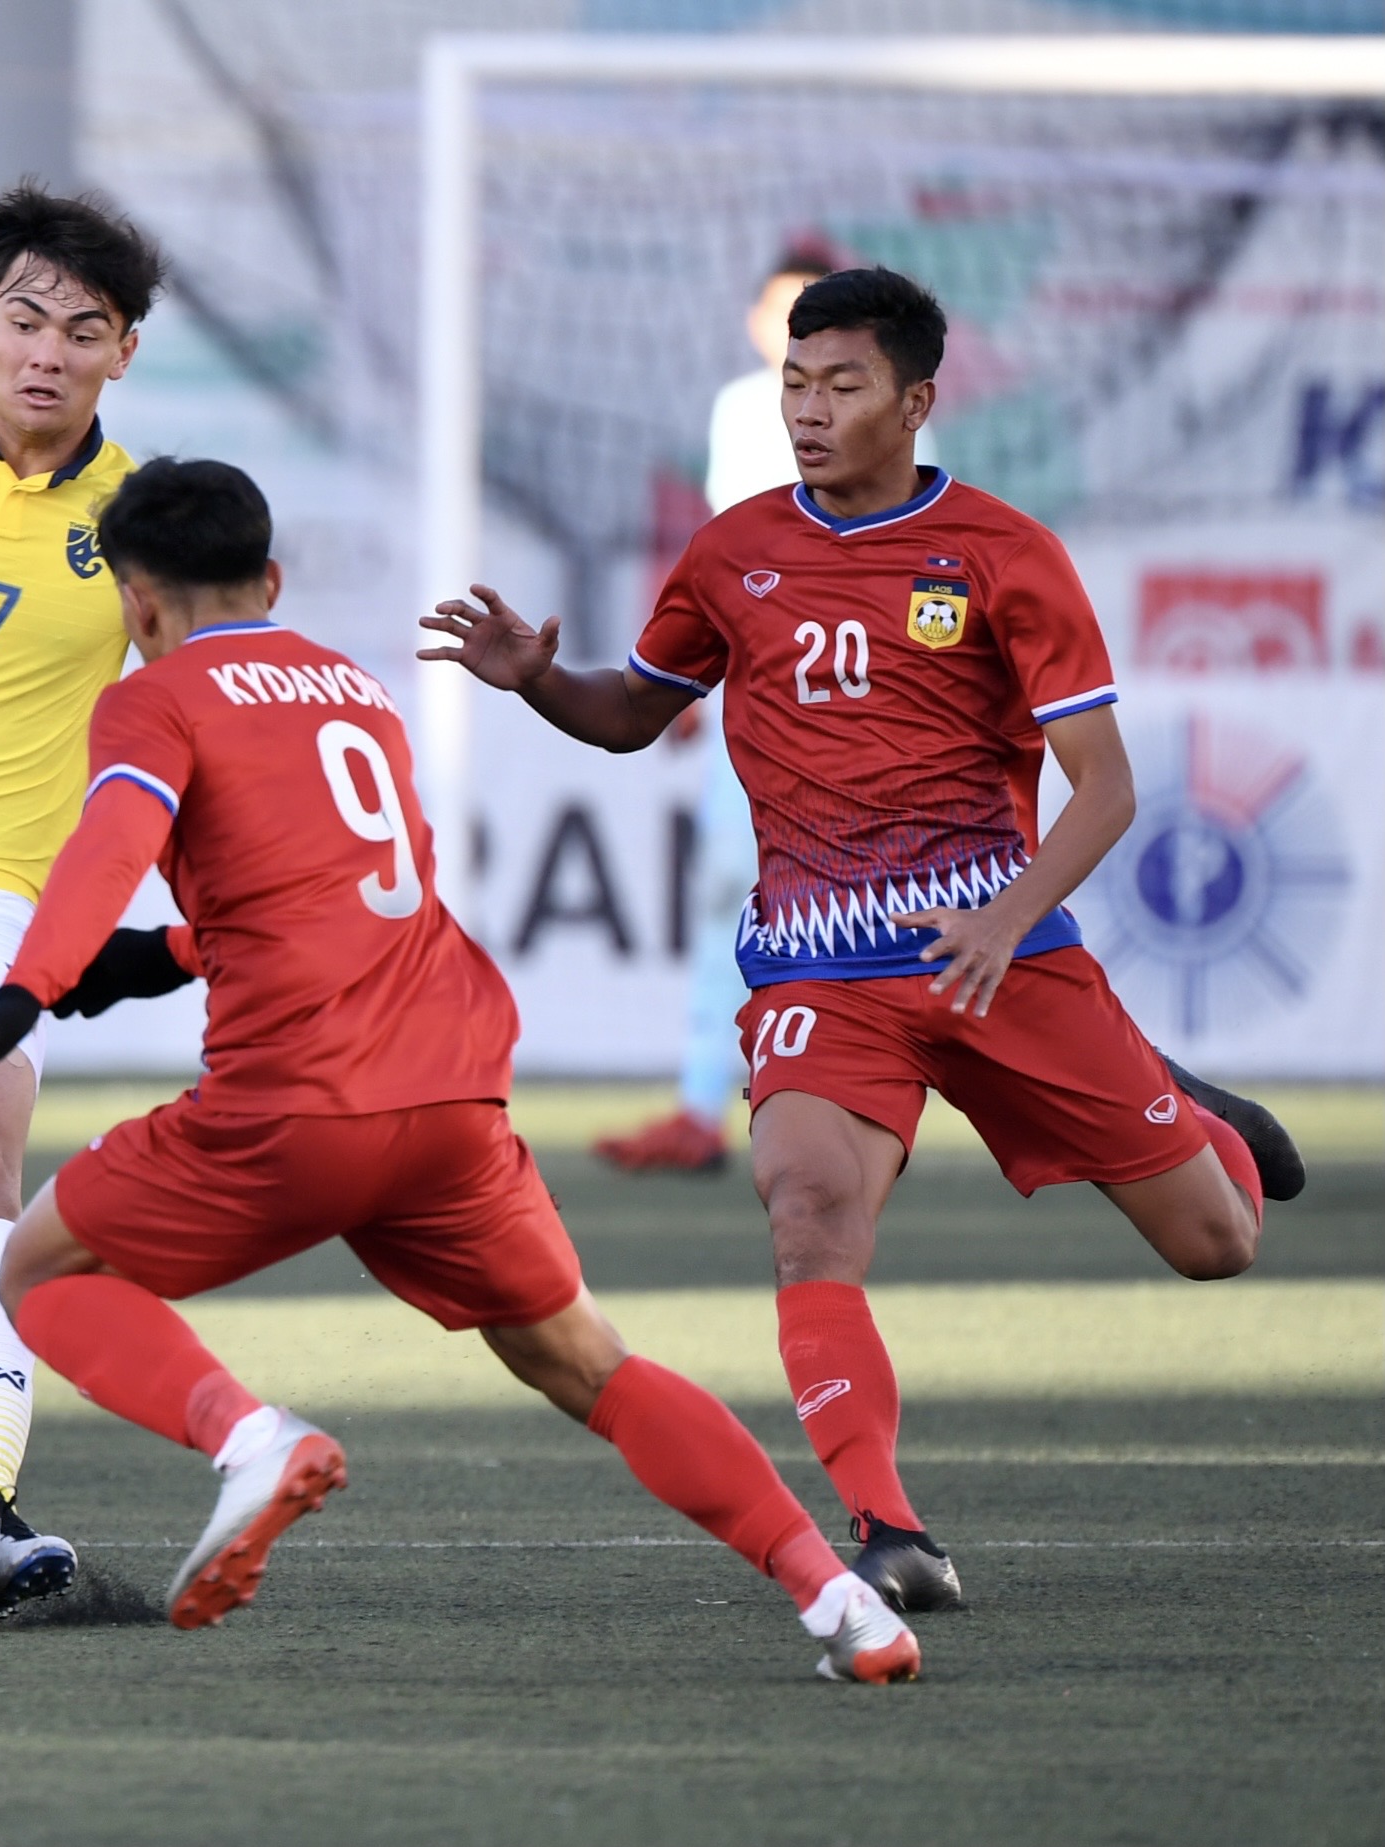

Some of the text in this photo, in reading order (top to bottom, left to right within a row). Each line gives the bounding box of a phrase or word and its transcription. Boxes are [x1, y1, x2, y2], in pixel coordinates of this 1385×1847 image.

[928, 584, 953, 595] LAOS
[794, 620, 871, 704] 20
[317, 719, 423, 919] 9
[752, 1006, 817, 1083] 20
